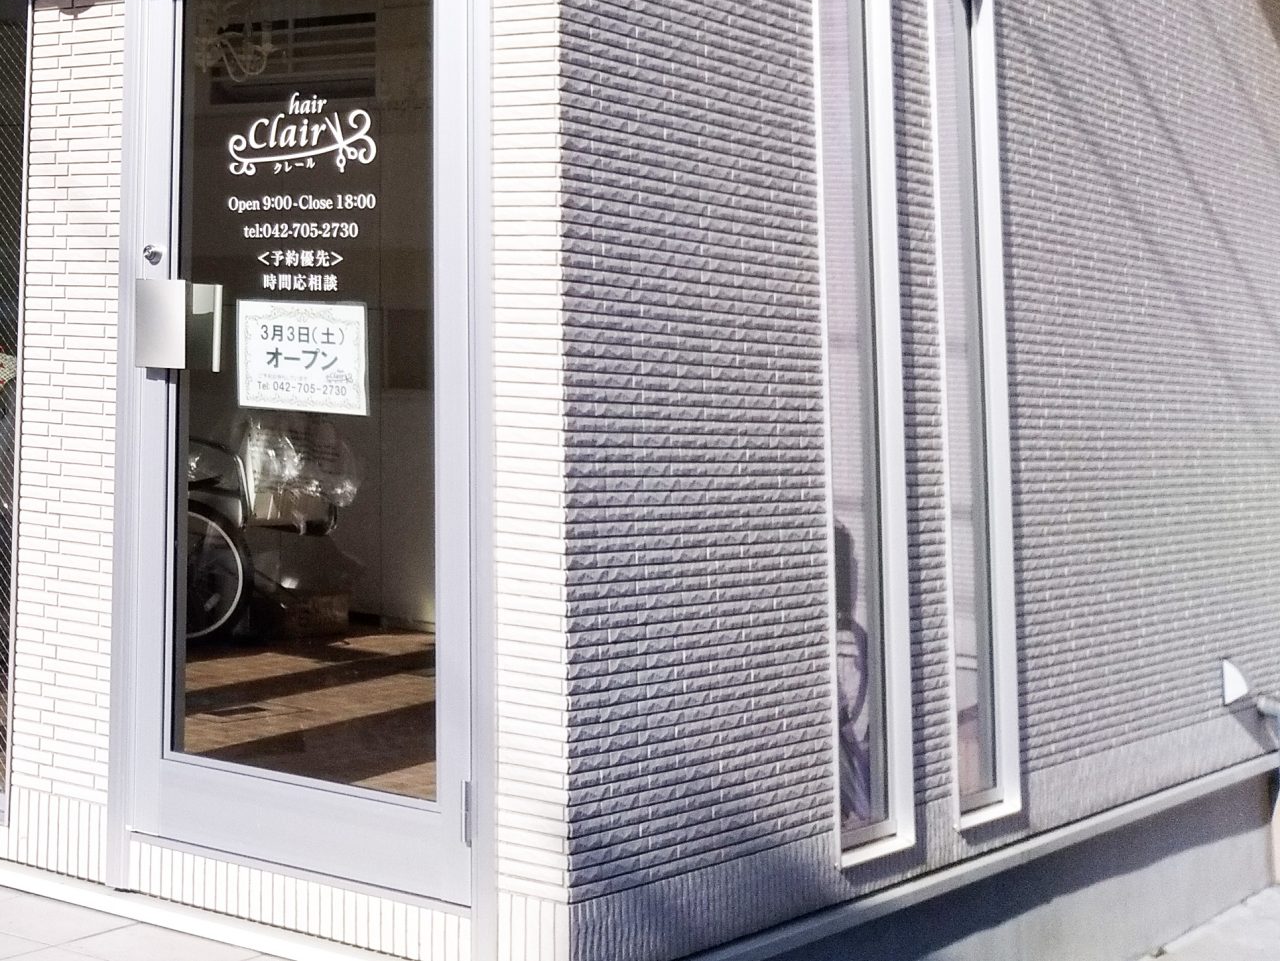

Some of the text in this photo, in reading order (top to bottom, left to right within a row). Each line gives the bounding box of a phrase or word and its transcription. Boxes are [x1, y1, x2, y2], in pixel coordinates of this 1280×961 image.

[288, 92, 328, 116] hair
[249, 114, 328, 150] Clair
[273, 159, 316, 175] クレール
[228, 197, 260, 212] Open
[336, 194, 376, 210] 18:00
[263, 274, 338, 292] 時間応相談
[266, 347, 338, 371] オープン
[272, 381, 347, 396] 042-705-2730
